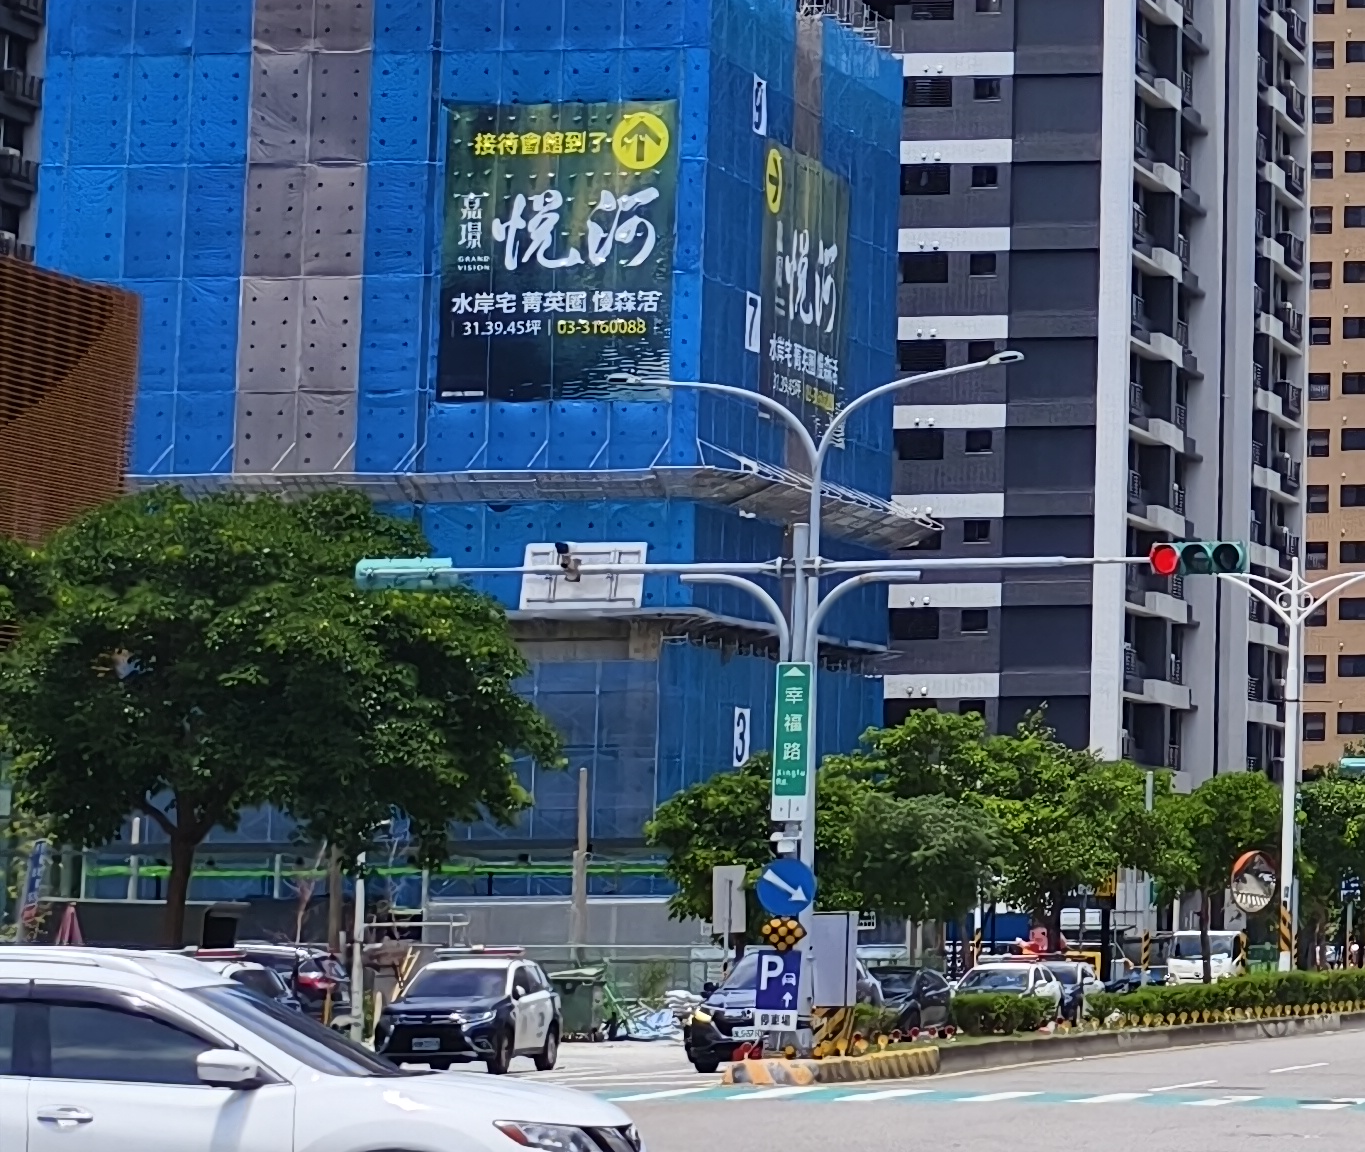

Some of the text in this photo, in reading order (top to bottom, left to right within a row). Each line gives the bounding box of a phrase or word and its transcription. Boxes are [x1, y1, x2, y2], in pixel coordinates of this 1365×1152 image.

[474, 131, 607, 156] 接待會館到了
[457, 255, 490, 263] GRAND
[451, 292, 517, 315] 水岸宅
[462, 319, 542, 337] 31.39.45坪
[748, 297, 758, 348] 7
[735, 711, 747, 763] 3
[783, 686, 804, 761] 幸福路
[759, 954, 785, 991] P
